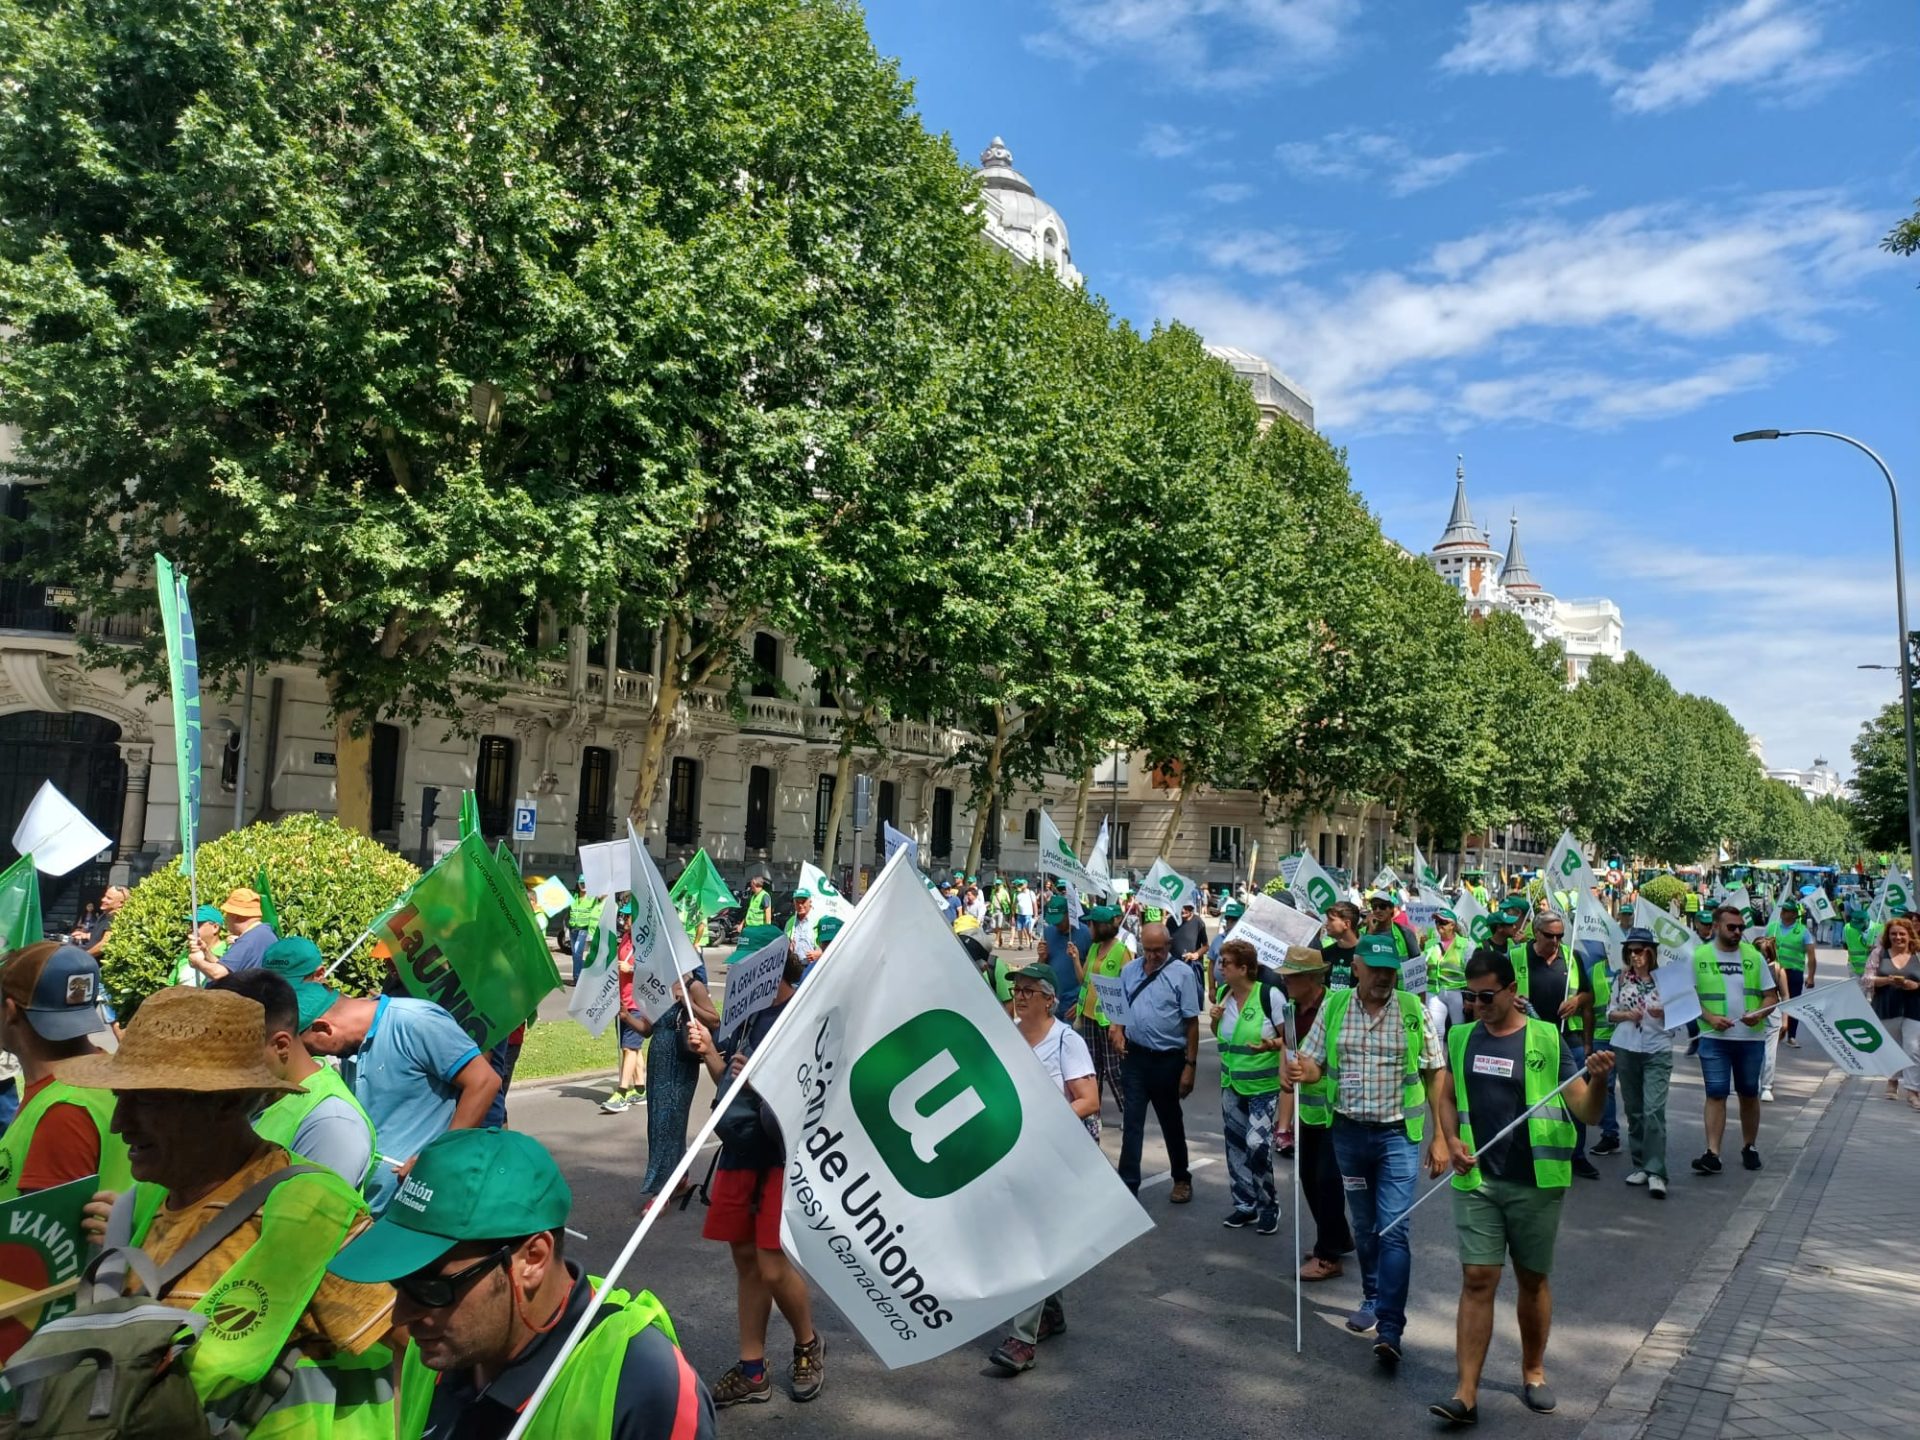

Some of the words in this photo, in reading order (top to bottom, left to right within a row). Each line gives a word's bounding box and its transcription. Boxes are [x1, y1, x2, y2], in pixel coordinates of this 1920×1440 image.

[518, 810, 530, 830] P
[729, 981, 736, 999] A
[737, 965, 757, 993] GRAN
[724, 997, 748, 1026] URGEN
[805, 1126, 848, 1183] de
[841, 1172, 953, 1330] Uniones
[808, 1215, 835, 1231] y
[828, 1233, 918, 1341] Ganaderos
